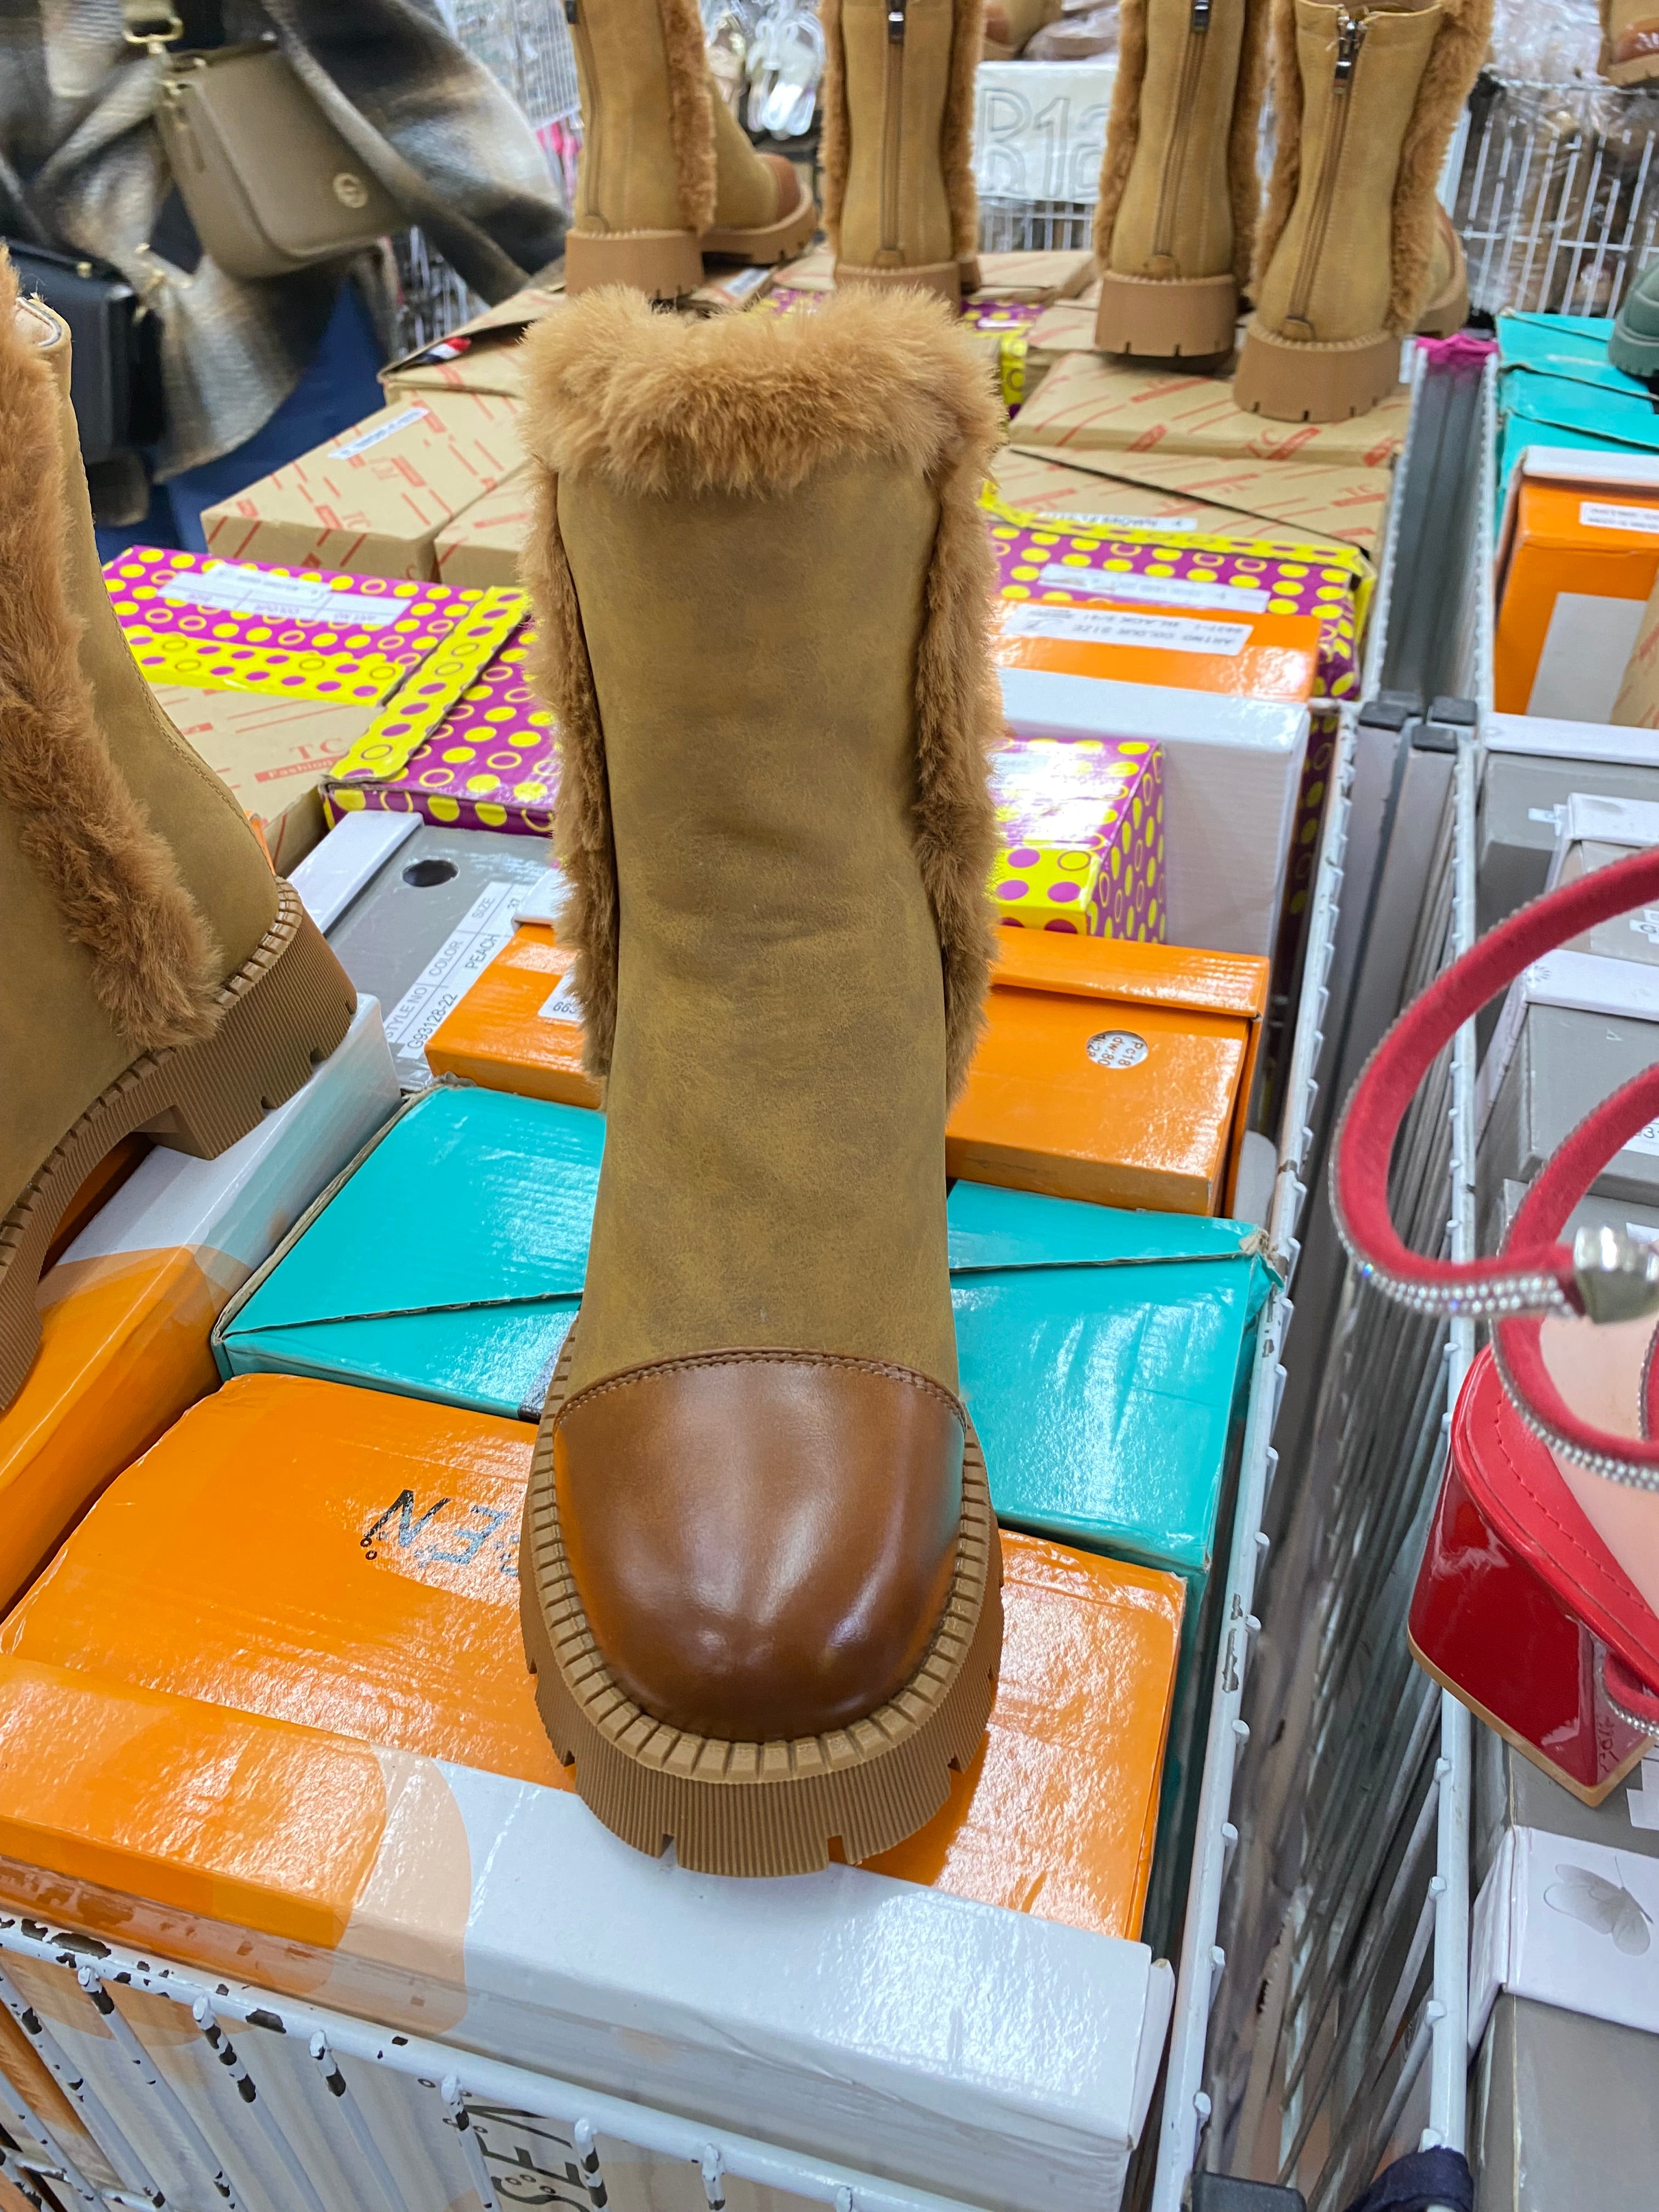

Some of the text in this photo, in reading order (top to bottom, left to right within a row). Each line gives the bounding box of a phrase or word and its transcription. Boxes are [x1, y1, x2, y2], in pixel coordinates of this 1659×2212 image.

[268, 759, 334, 780] Fashion
[289, 737, 347, 759] TC
[386, 897, 495, 1039] STYLE NO COLOR SIZE
[407, 992, 459, 1050] G93128-22
[464, 933, 501, 969] PEACH
